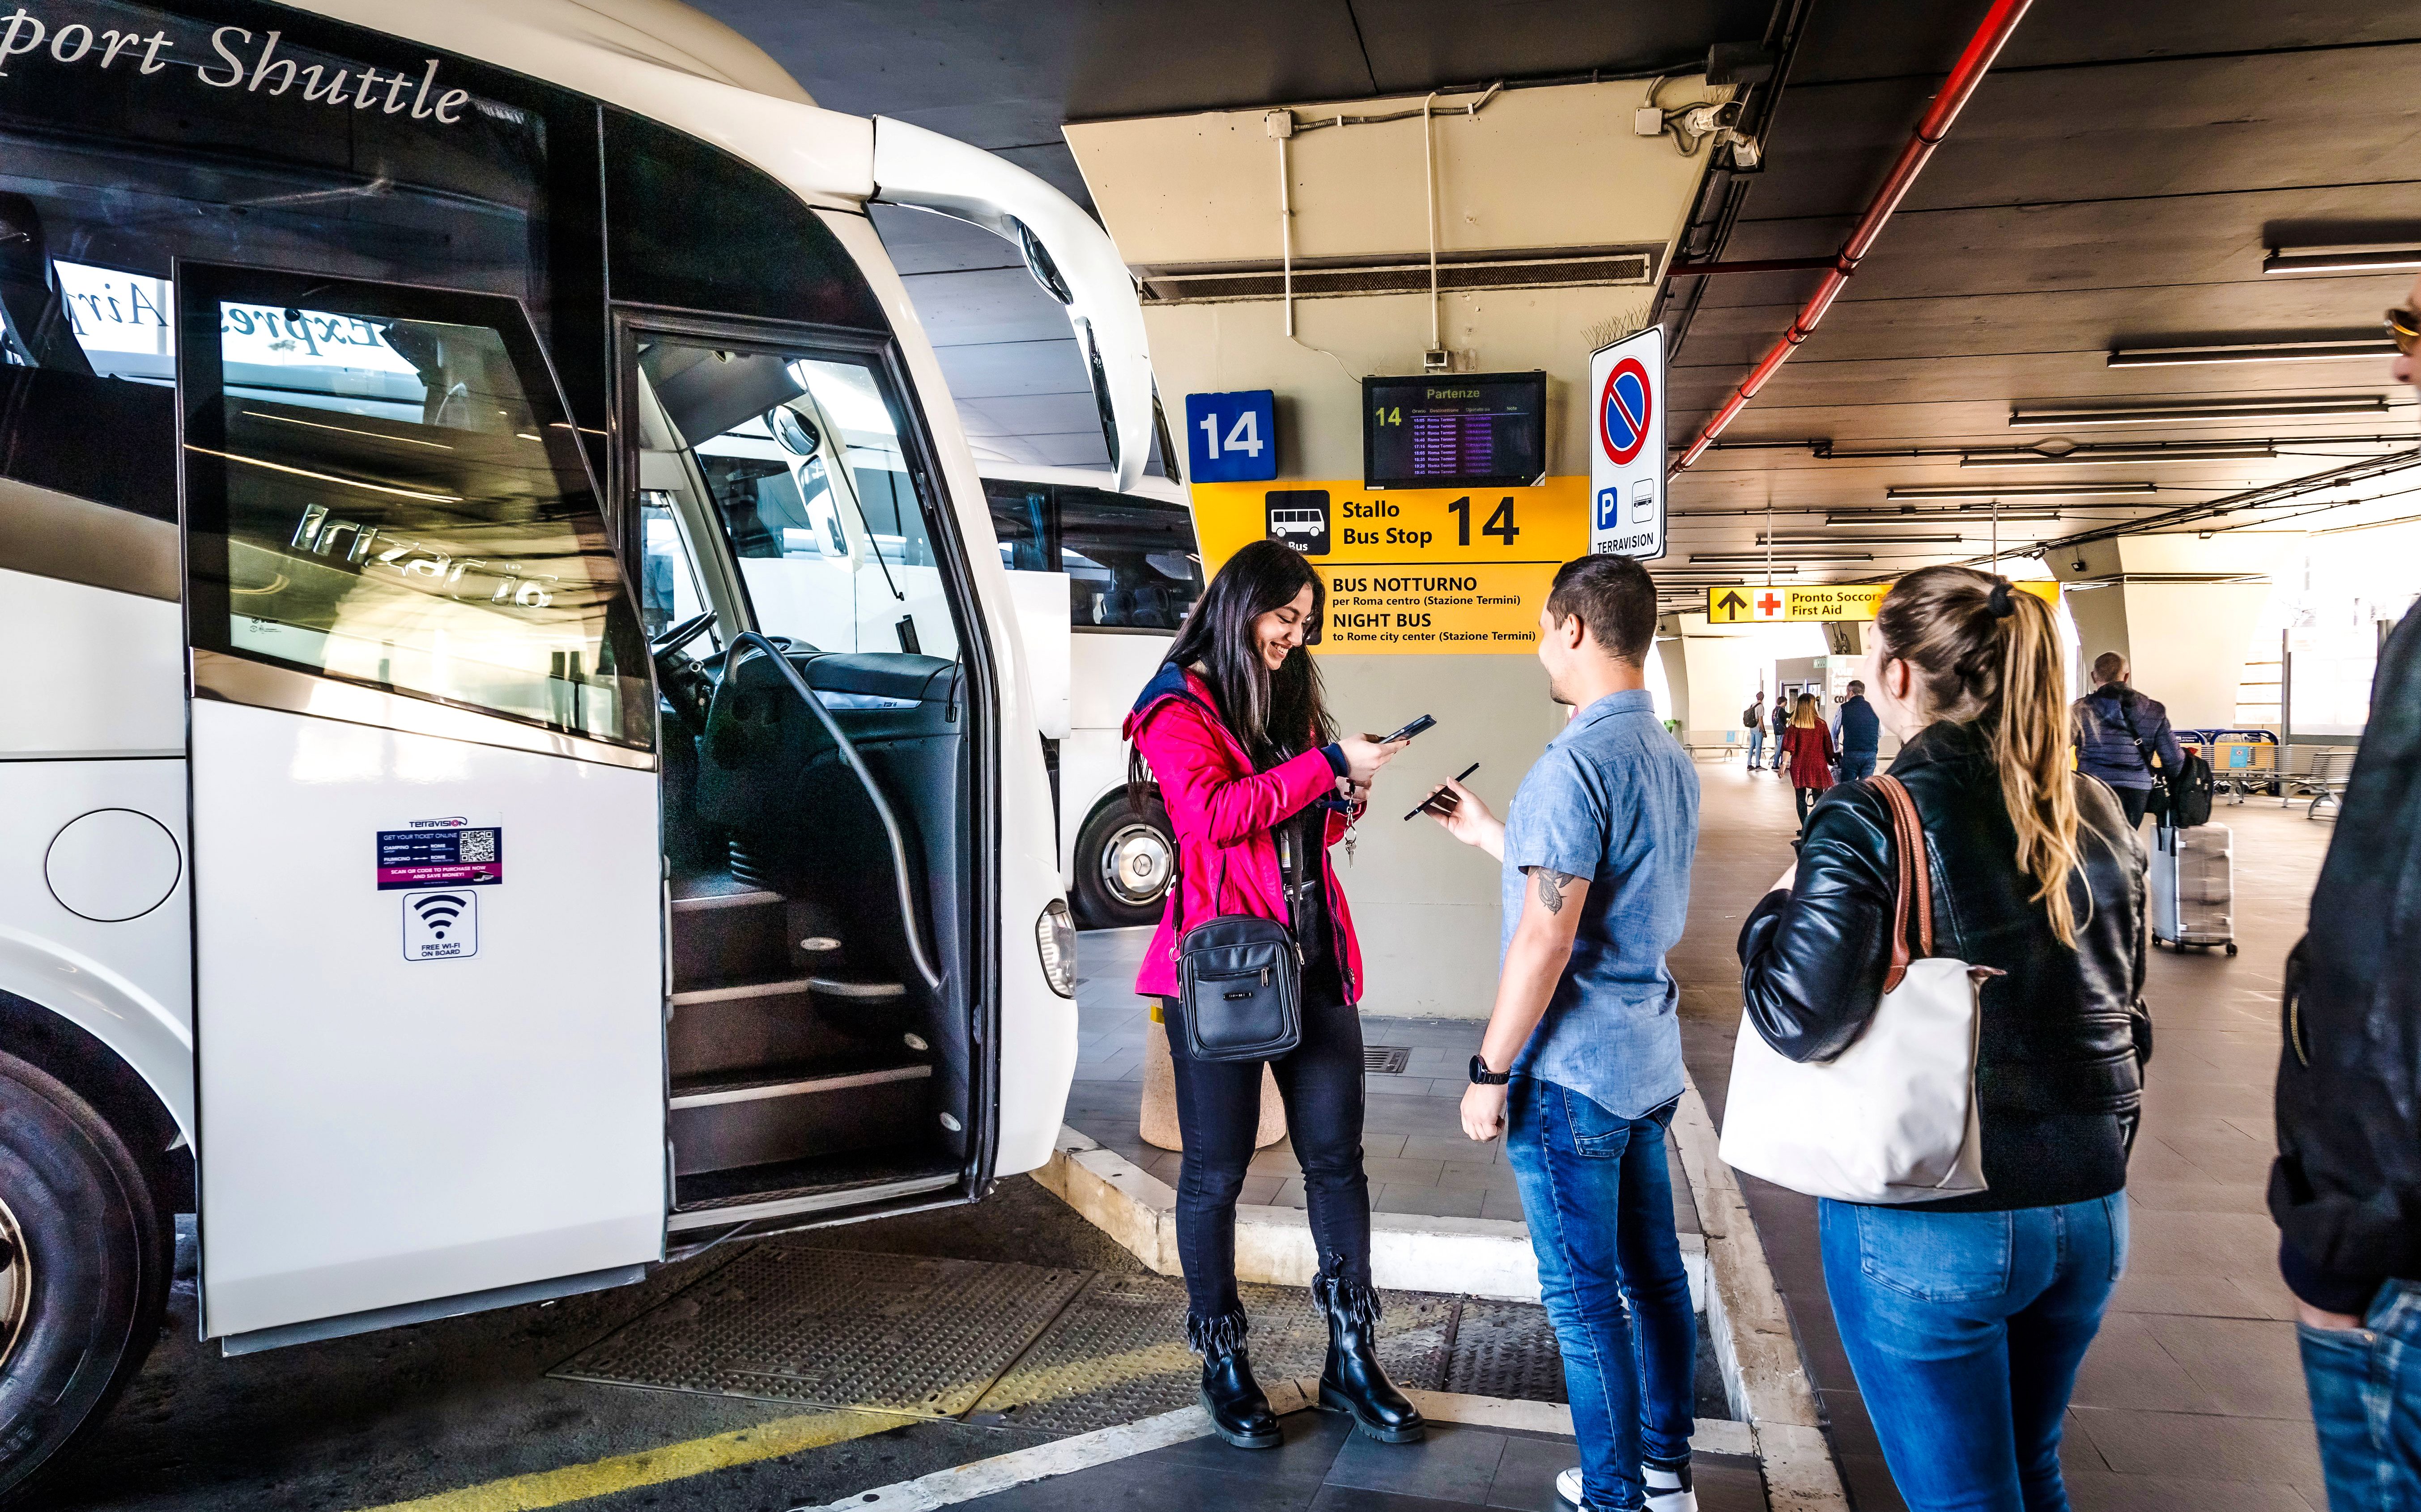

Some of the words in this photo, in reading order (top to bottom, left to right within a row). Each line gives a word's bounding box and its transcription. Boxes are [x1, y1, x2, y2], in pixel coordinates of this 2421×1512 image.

[0, 8, 173, 76] port
[198, 26, 468, 123] Shuttle
[1427, 389, 1480, 399] Partenze
[1376, 407, 1402, 426] 14
[1200, 410, 1263, 459] 14
[1343, 501, 1400, 518] Stallo
[1602, 493, 1614, 525] P
[1344, 528, 1379, 544] Bus
[1387, 527, 1432, 548] Stop
[1449, 497, 1519, 546] 14
[1288, 542, 1308, 551] Bus
[1597, 532, 1654, 554] TERRAVISION
[1334, 578, 1367, 592] BUS
[1374, 577, 1476, 591] NOTTURNO
[1333, 599, 1349, 607] per
[1424, 596, 1472, 606] (Stazione
[1476, 595, 1520, 605] Termini)
[1793, 594, 1832, 602] Pronto
[1793, 606, 1817, 615] First
[1822, 605, 1841, 614] Aid
[1334, 614, 1390, 627] NIGHT
[1397, 613, 1431, 627] BUS
[1380, 632, 1399, 643] city
[1439, 632, 1488, 641] (Stazione
[1492, 631, 1535, 641] Termini)
[1832, 667, 1854, 677] your
